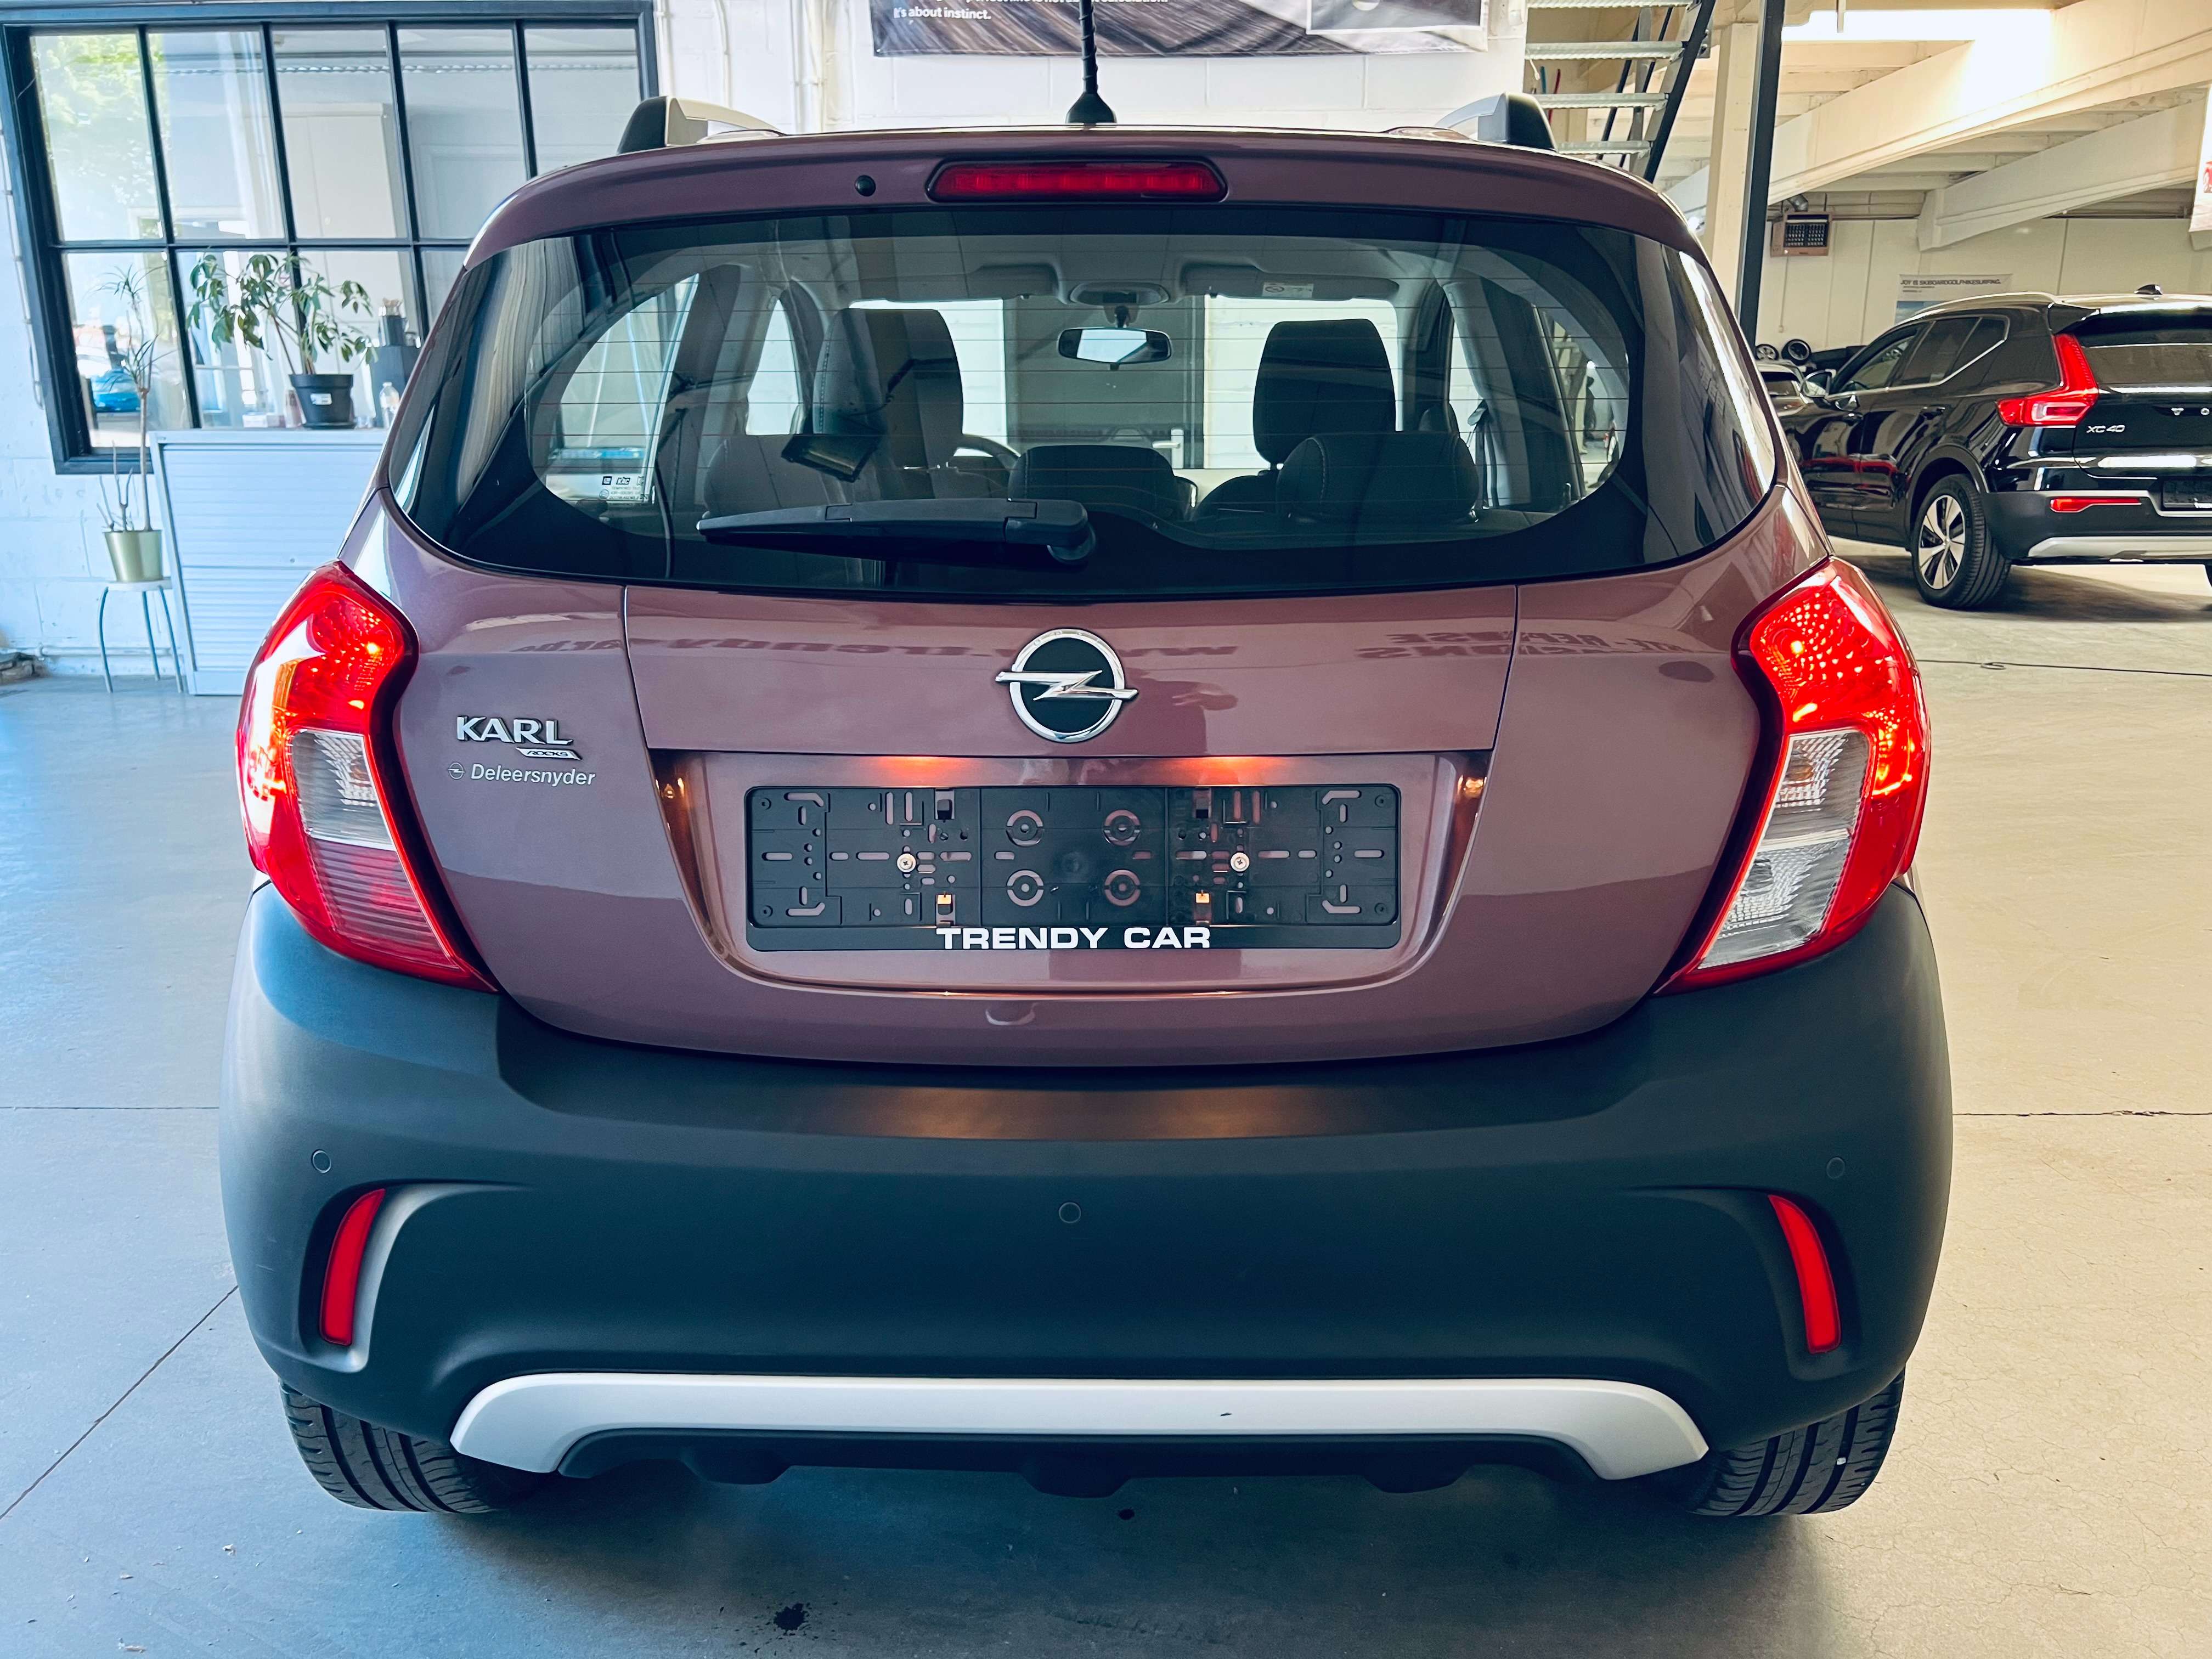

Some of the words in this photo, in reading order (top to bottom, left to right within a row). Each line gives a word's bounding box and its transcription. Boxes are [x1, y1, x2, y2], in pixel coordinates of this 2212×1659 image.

[893, 7, 907, 18] It's
[908, 6, 943, 18] about
[943, 7, 992, 20] instinct.
[457, 715, 573, 745] KARL
[471, 763, 596, 787] Deleersnyder
[936, 927, 1108, 949] TRENDY
[1124, 927, 1210, 949] CAR
